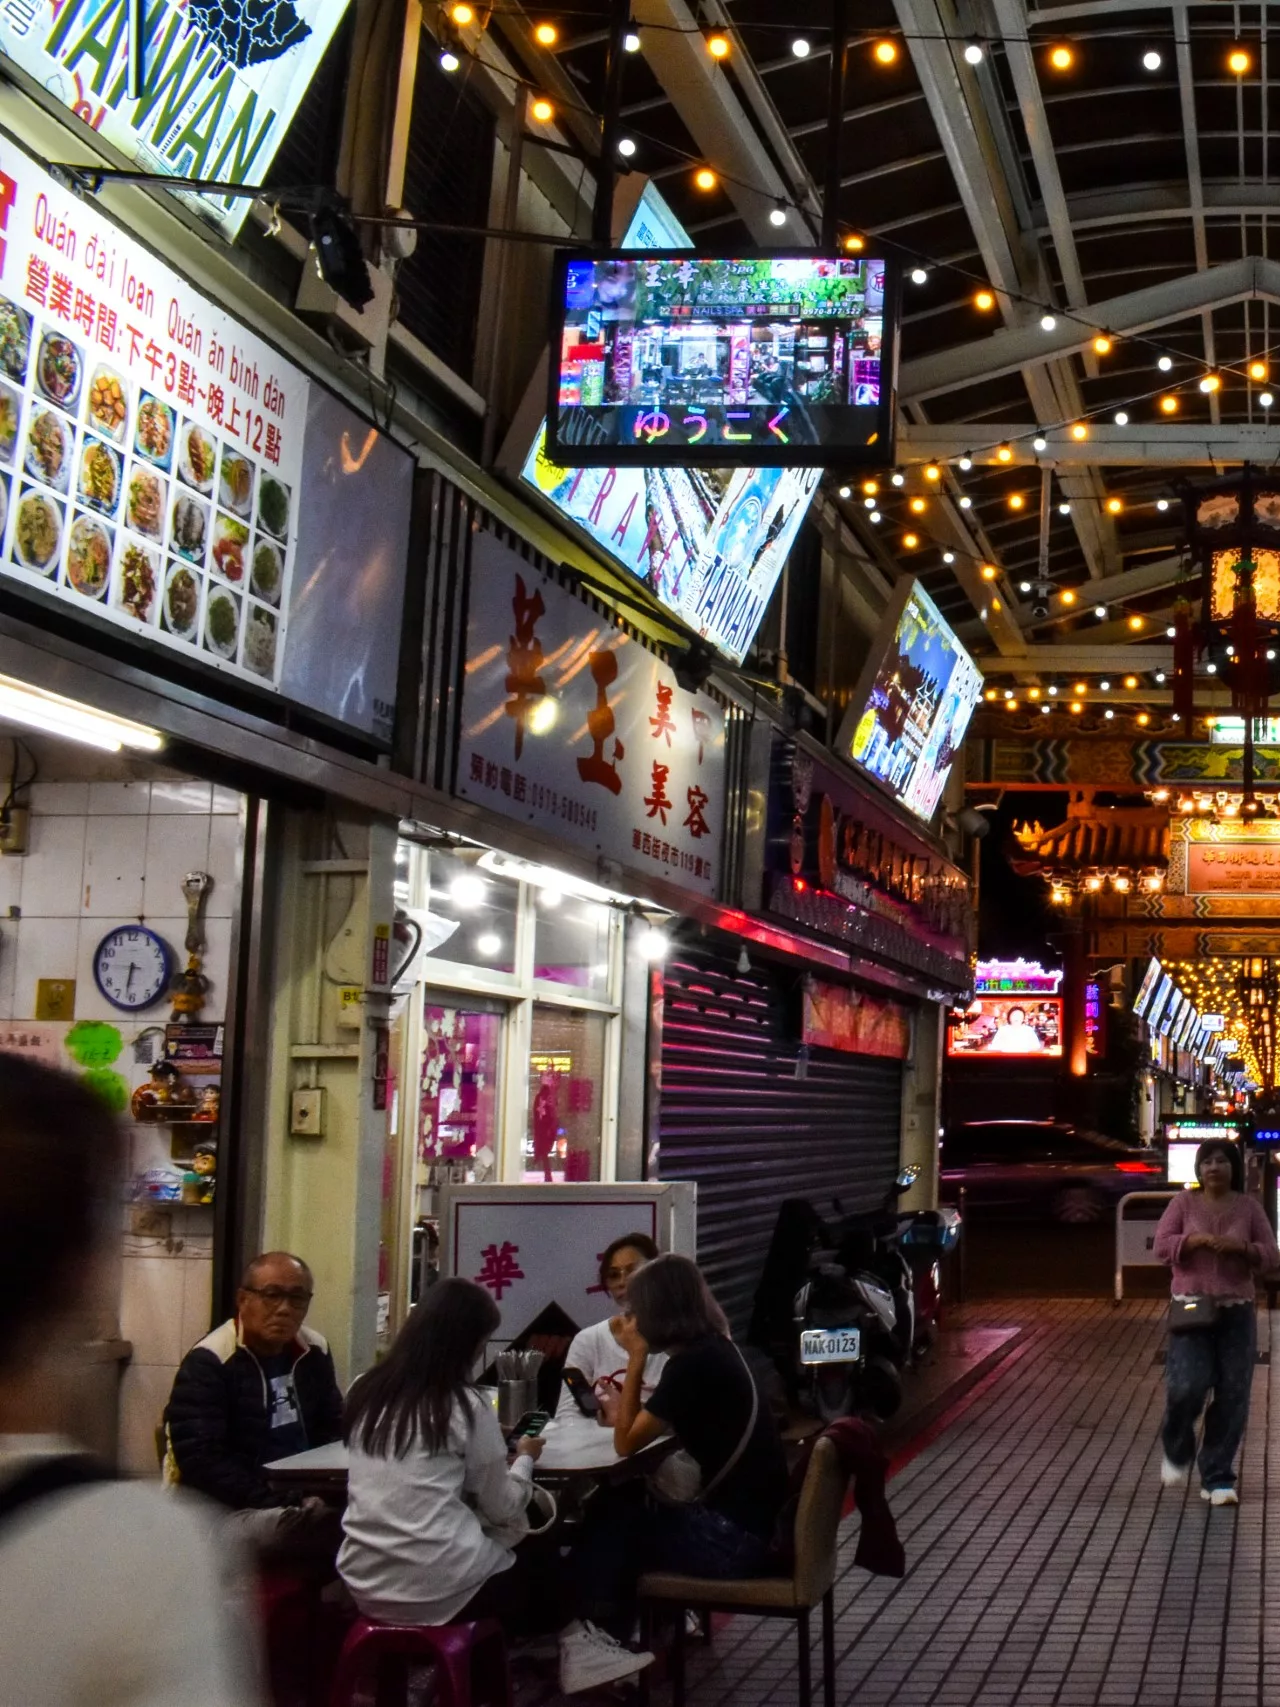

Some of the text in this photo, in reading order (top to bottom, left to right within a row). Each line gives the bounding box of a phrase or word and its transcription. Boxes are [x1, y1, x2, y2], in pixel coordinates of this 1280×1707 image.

[33, 193, 76, 261] Quán
[122, 260, 154, 318] loan
[167, 298, 202, 357] Quán
[229, 345, 259, 400] bình
[263, 374, 286, 419] dân
[24, 253, 283, 467] 營業時間:下午3點~晚上12點
[633, 405, 790, 444] ゆうこく
[695, 555, 764, 653] TAIWAN
[474, 1241, 525, 1300] 華
[804, 1338, 856, 1355] NAK-0123
